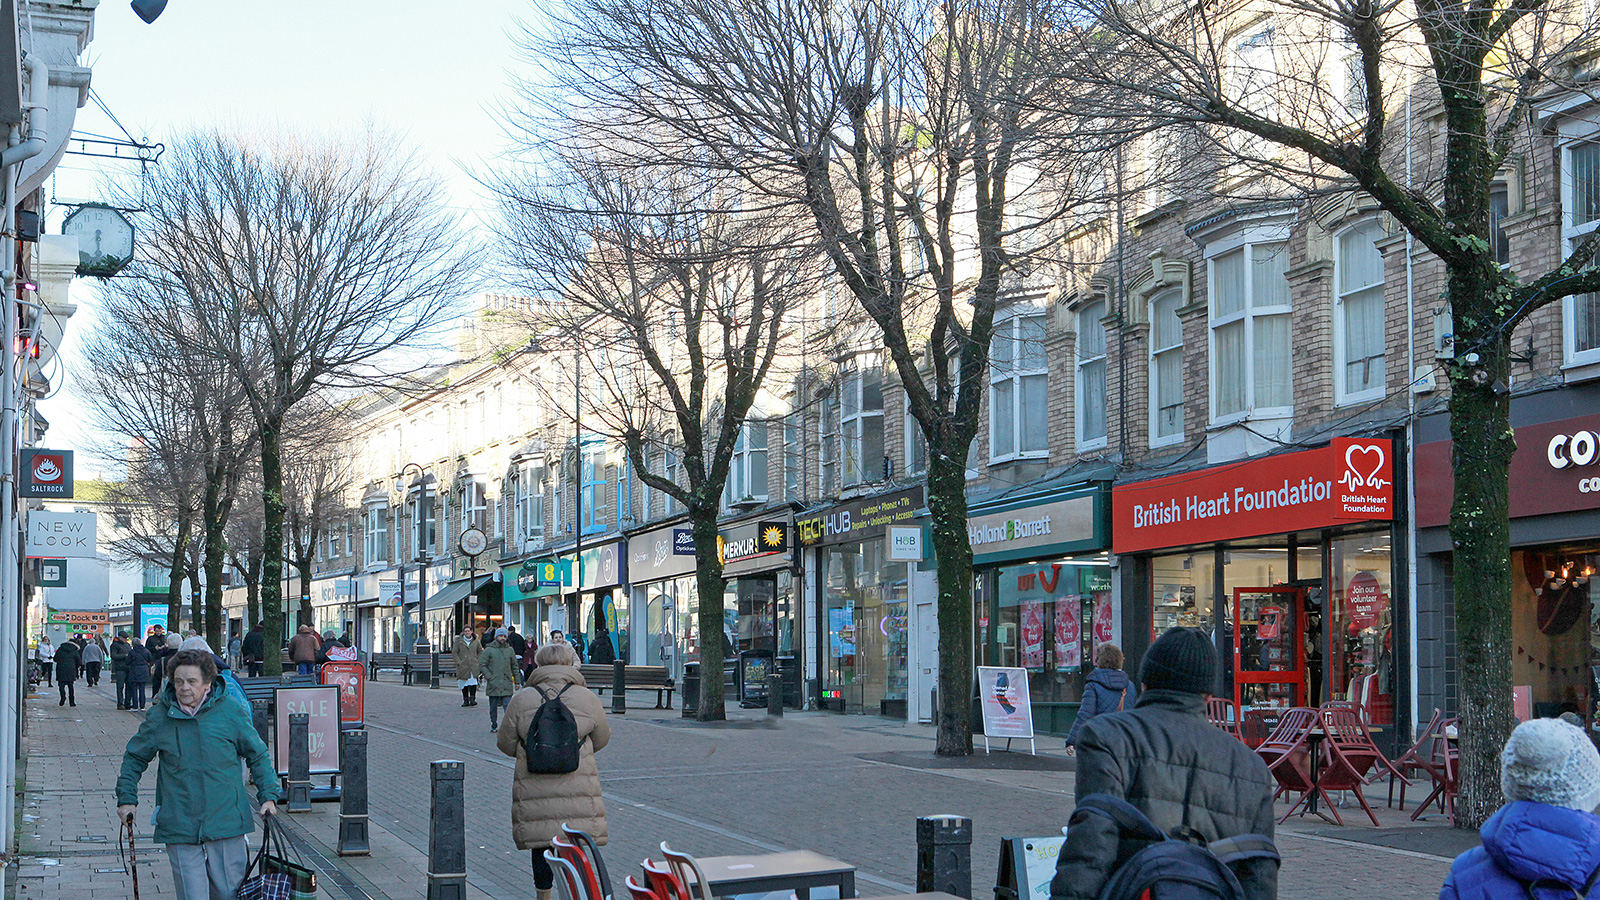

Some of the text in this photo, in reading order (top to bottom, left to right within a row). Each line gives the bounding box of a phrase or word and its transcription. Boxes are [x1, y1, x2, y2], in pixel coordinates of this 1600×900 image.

[74, 222, 83, 230] 10
[118, 225, 123, 233] 2
[1547, 430, 1600, 469] CO
[1341, 495, 1387, 504] British Heart
[860, 497, 910, 516] Laptops Phones TVs
[1133, 499, 1181, 528] British
[1186, 491, 1231, 520] Heart
[1343, 504, 1385, 513] Foundation
[851, 508, 917, 531] Repairs Unlocking Accesso
[38, 522, 83, 532] NEW
[1014, 515, 1051, 539] Barrett
[33, 536, 87, 547] LOOK
[723, 537, 755, 560] MERKUR
[1351, 585, 1376, 594] Join our
[1350, 594, 1378, 603] volunteer
[1356, 604, 1372, 612] team
[286, 700, 329, 718] SALE
[308, 732, 325, 754] 0%
